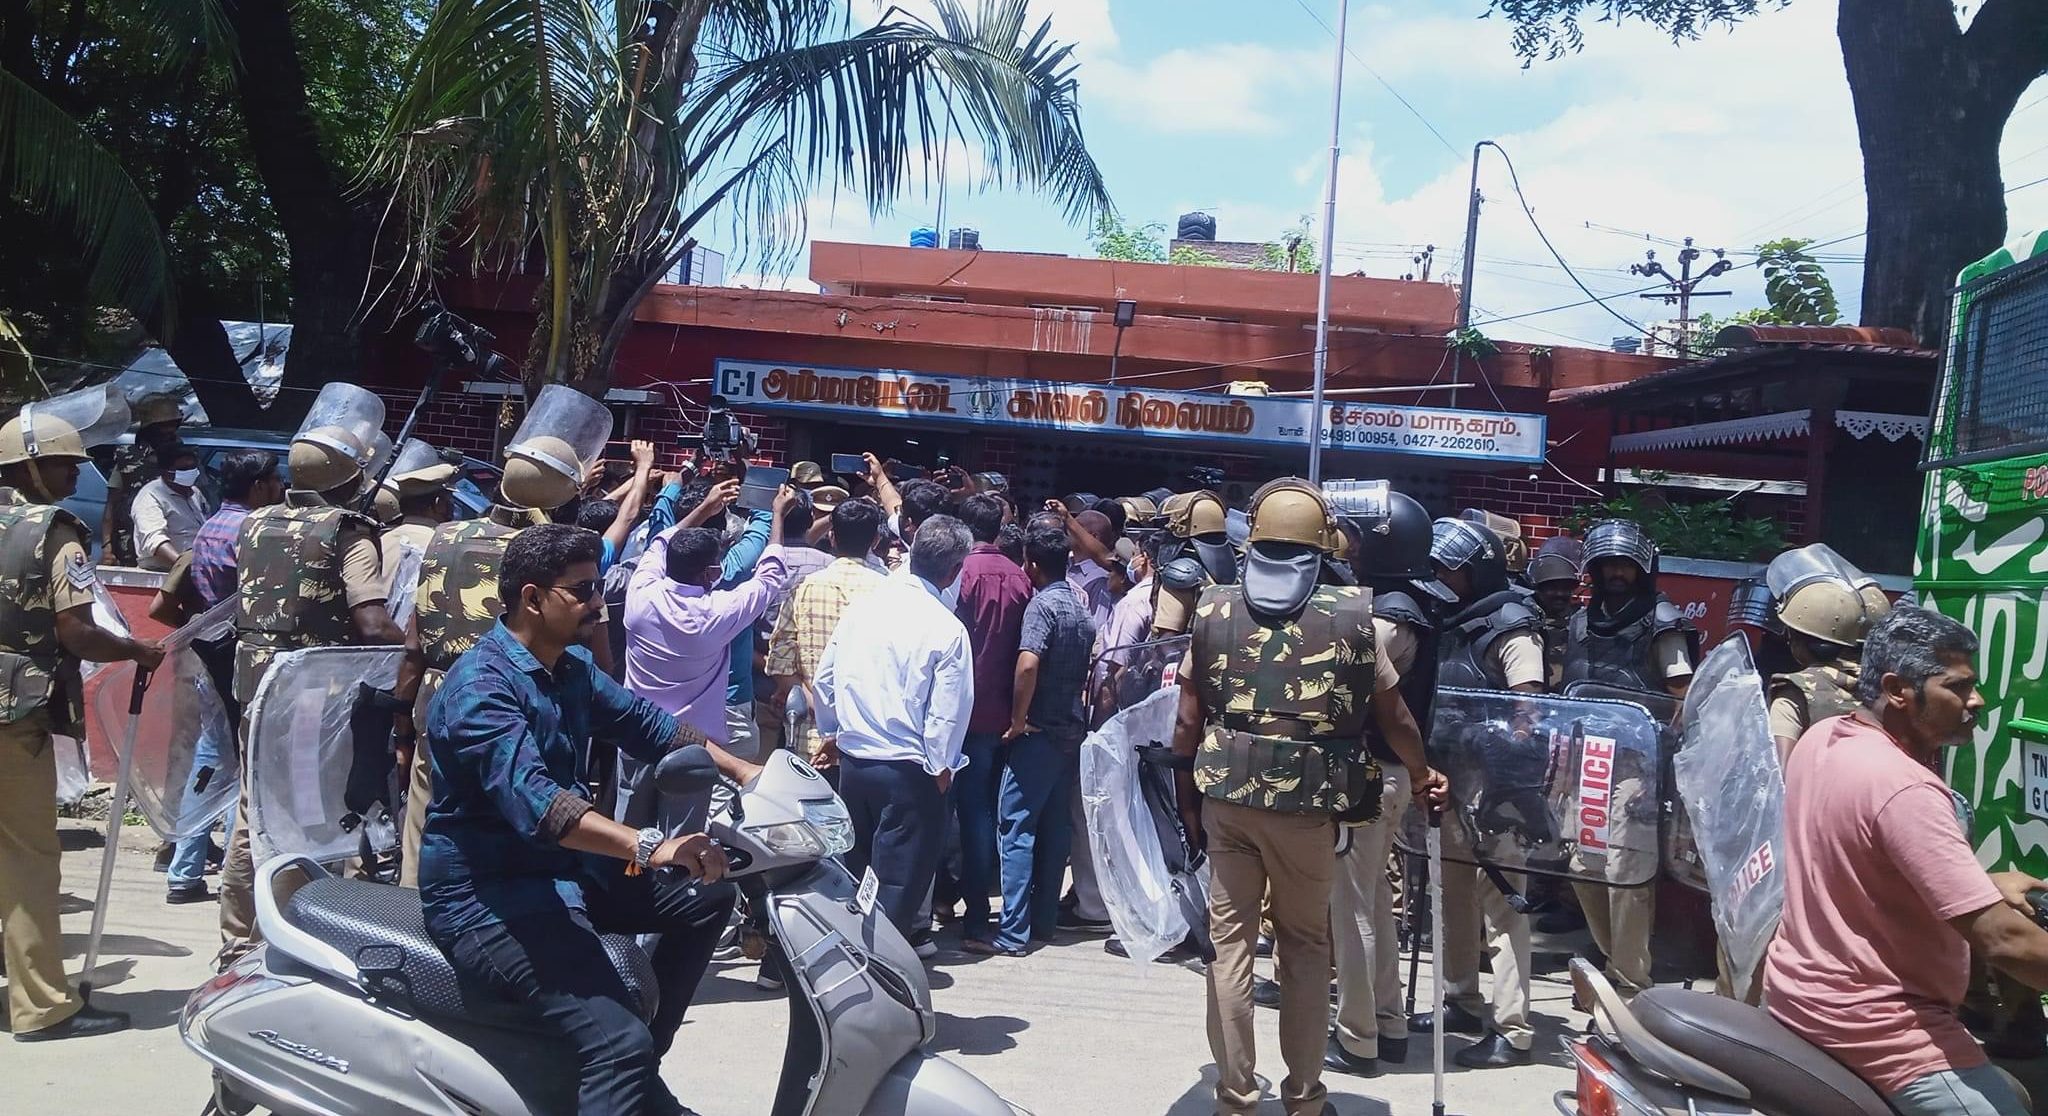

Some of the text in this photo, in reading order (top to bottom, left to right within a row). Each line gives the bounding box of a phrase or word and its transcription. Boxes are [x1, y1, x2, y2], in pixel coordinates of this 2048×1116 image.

[722, 369, 756, 396] C-1
[1008, 390, 1109, 424] காவல்
[1115, 392, 1254, 435] நிலையம்
[1330, 406, 1521, 437] சேலம் மாநகரம்.
[2022, 465, 2048, 500] PO
[1580, 741, 1613, 849] POLICE
[1728, 843, 1773, 902] LICE
